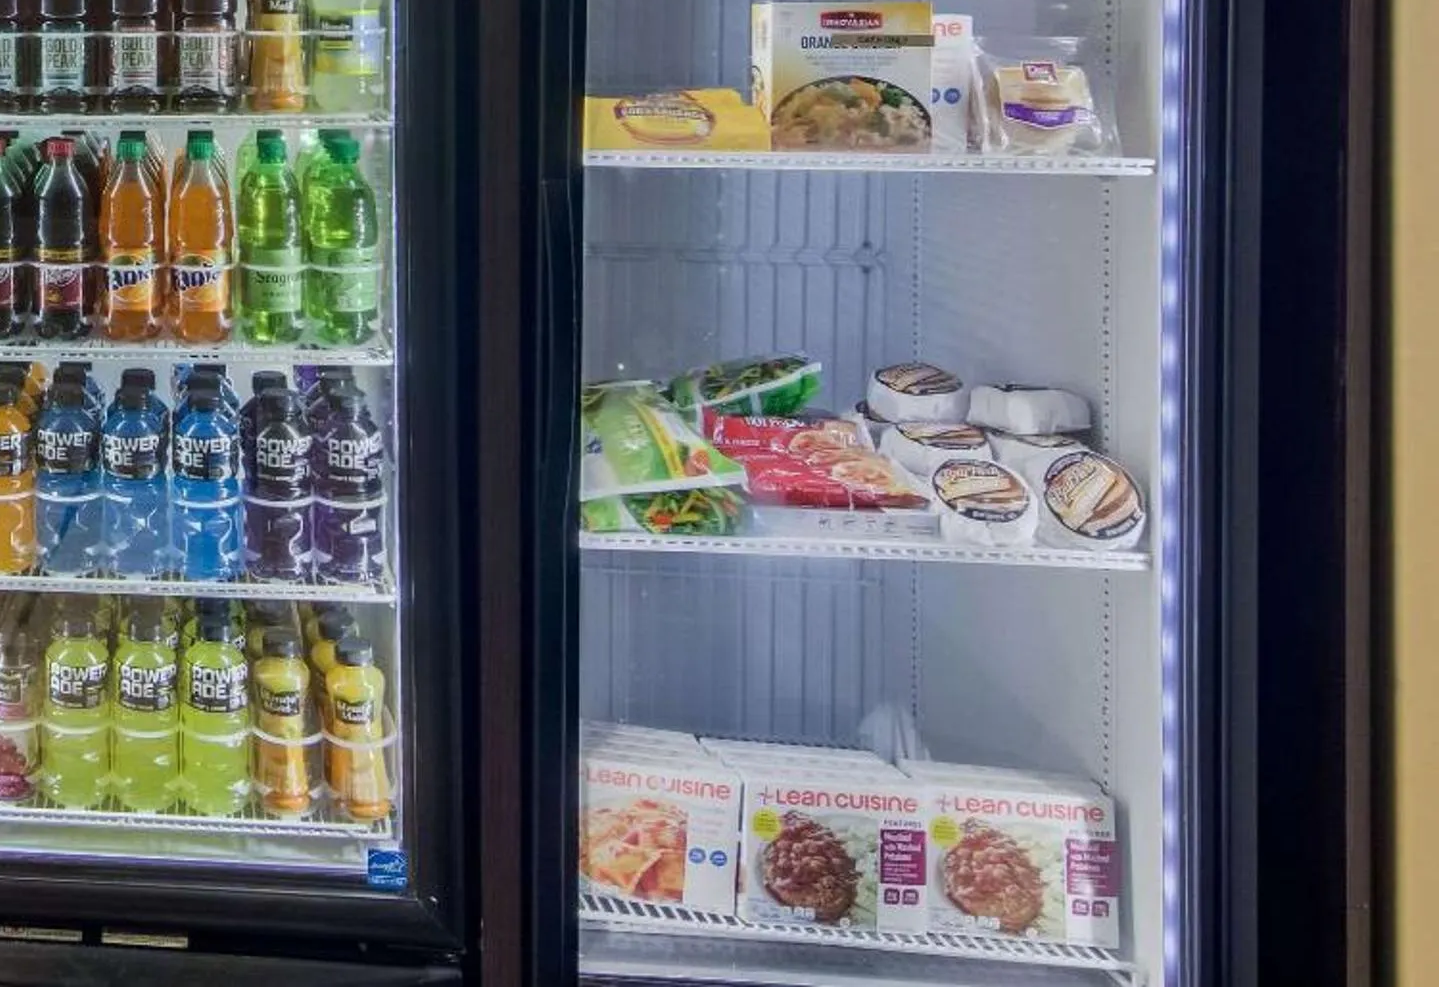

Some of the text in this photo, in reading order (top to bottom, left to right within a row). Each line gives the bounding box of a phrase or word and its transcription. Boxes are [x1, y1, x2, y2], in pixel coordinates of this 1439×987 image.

[801, 36, 833, 50] ORAN
[37, 430, 93, 447] POWER
[257, 435, 312, 455] POWER
[328, 433, 383, 455] POWER
[51, 662, 107, 683] POWER
[121, 663, 177, 684] POWER
[193, 663, 248, 684] POWER
[121, 681, 155, 698] ADE
[193, 681, 225, 698] ADE
[586, 765, 731, 801] Lean cuisine
[775, 786, 918, 814] Lean cuisine
[954, 794, 1105, 823] Lean cuisine
